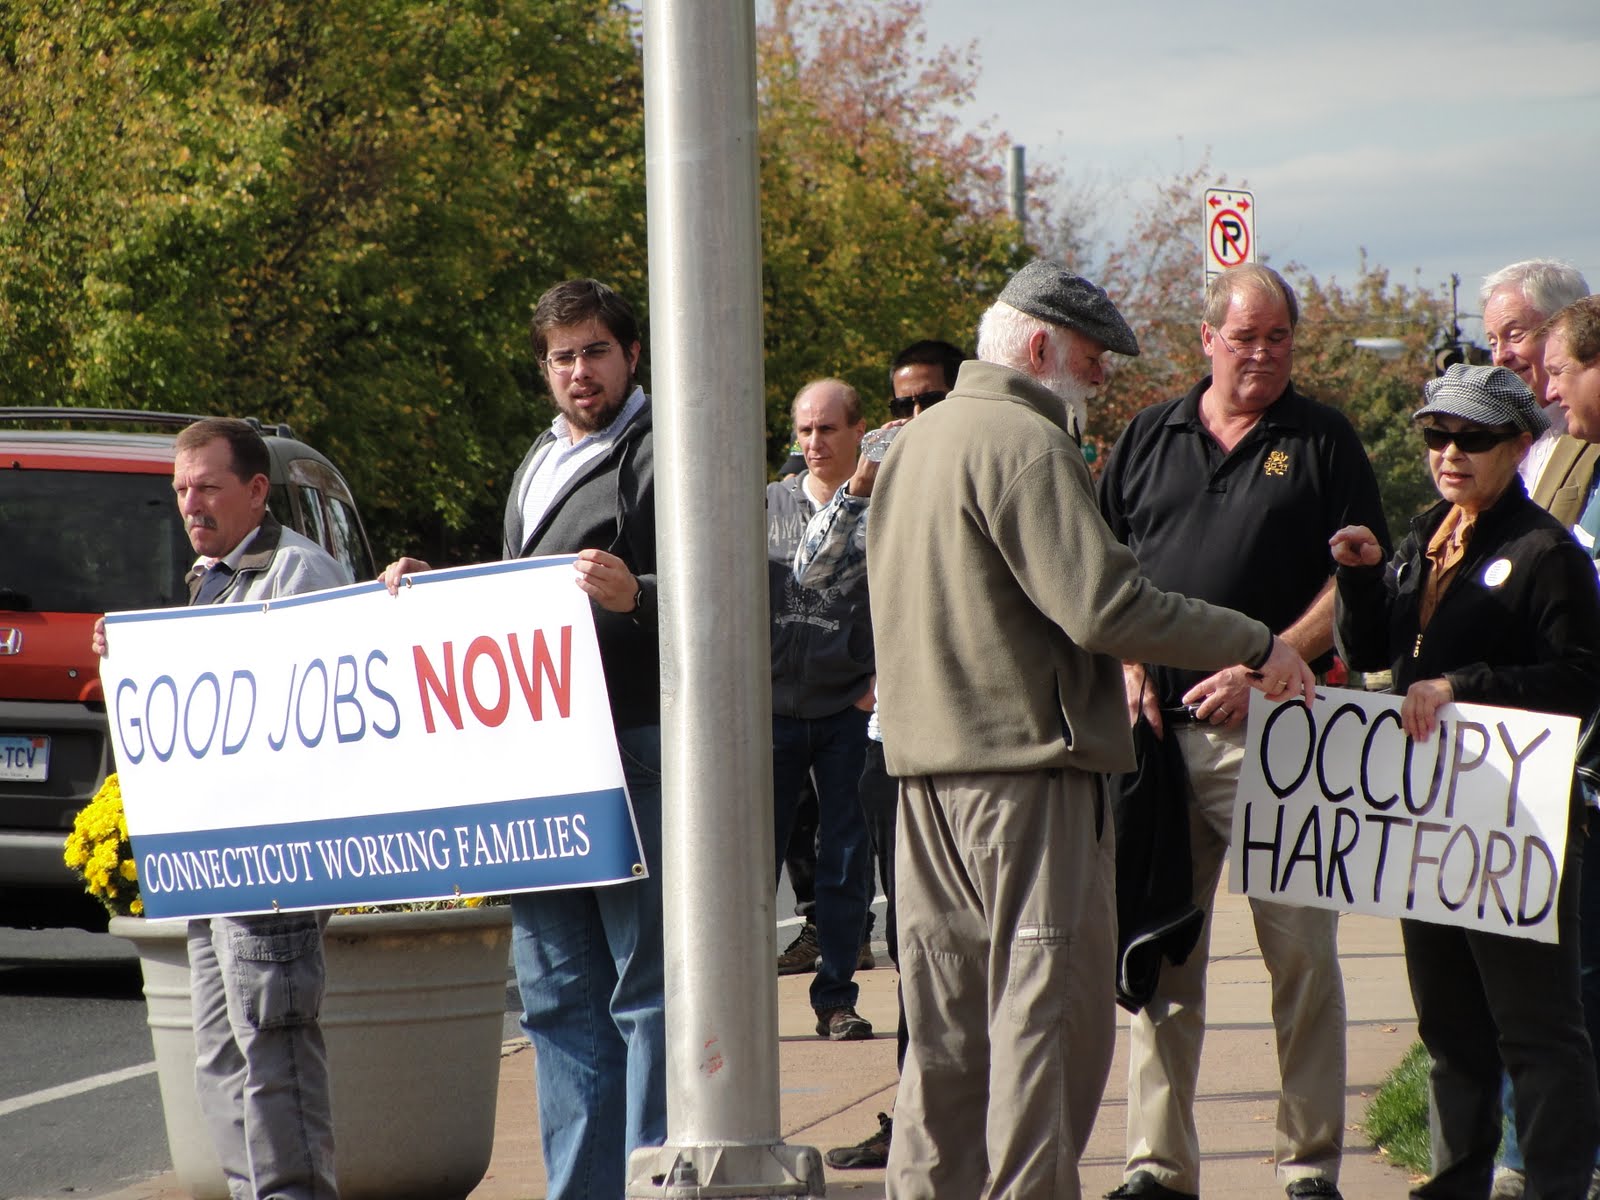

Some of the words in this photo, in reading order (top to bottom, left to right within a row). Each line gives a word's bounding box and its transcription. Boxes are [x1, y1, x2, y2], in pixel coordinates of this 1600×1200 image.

[1222, 220, 1241, 256] P
[116, 670, 257, 764] GOOD
[268, 650, 400, 751] JOBS
[412, 625, 572, 733] NOW
[1260, 699, 1551, 827] OCCUPY
[144, 841, 313, 894] CONNECTICUT
[315, 828, 450, 880] WORKING
[453, 814, 590, 867] FAMILIES
[1242, 802, 1557, 926] HARTFORD
